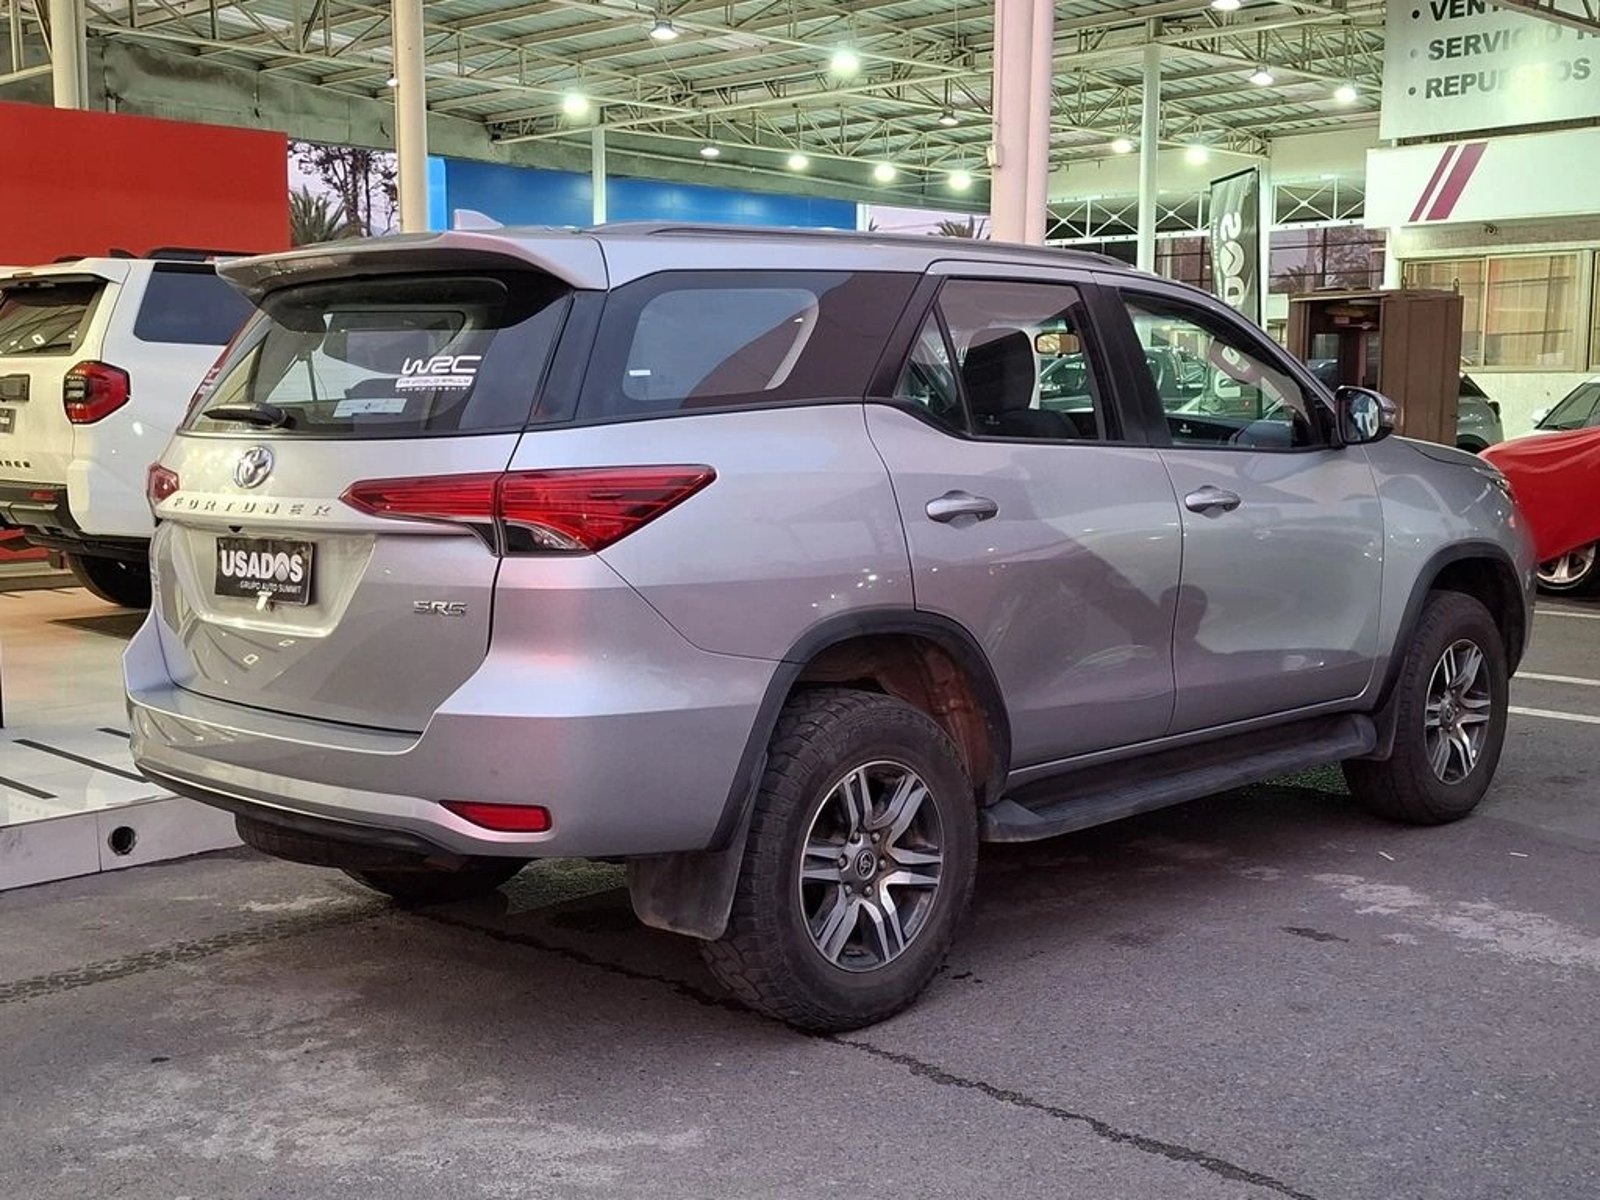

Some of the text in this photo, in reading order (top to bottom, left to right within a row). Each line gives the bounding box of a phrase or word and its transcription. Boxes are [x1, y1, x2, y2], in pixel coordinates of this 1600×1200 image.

[1430, 0, 1499, 21] VEN
[1425, 58, 1591, 98] REPUOS
[401, 355, 482, 375] WRC
[173, 497, 332, 517] FORTUNER
[221, 549, 304, 583] USADOS
